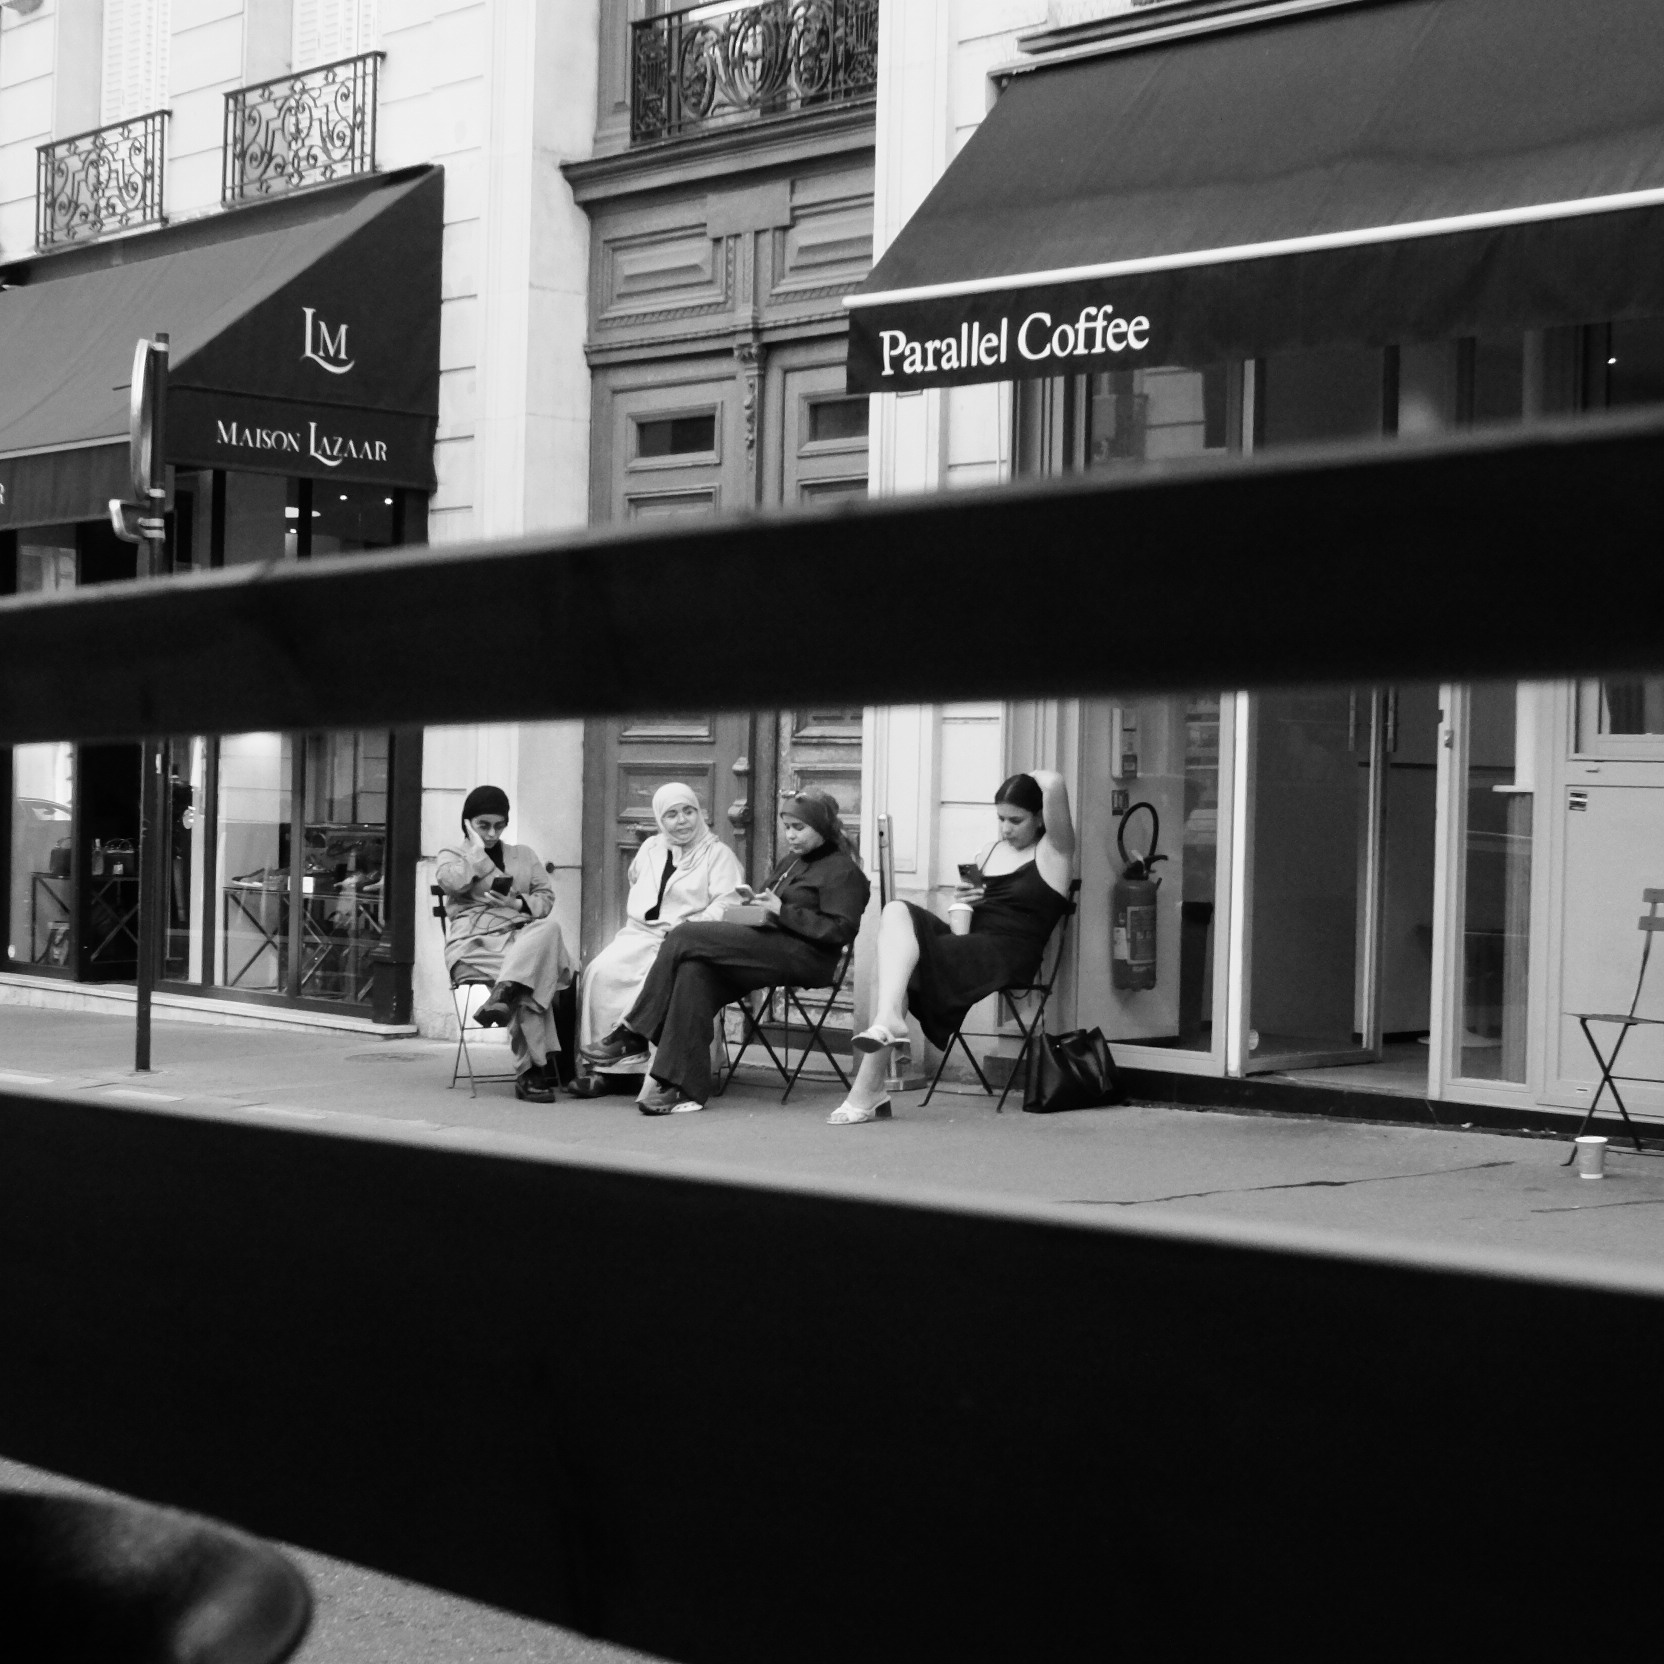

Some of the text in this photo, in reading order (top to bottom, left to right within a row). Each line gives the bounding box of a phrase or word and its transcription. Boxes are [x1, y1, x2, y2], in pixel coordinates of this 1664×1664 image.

[301, 307, 355, 374] LM
[878, 304, 1150, 376] Parallel Coffee
[216, 419, 387, 467] MAISON LAZAAR
